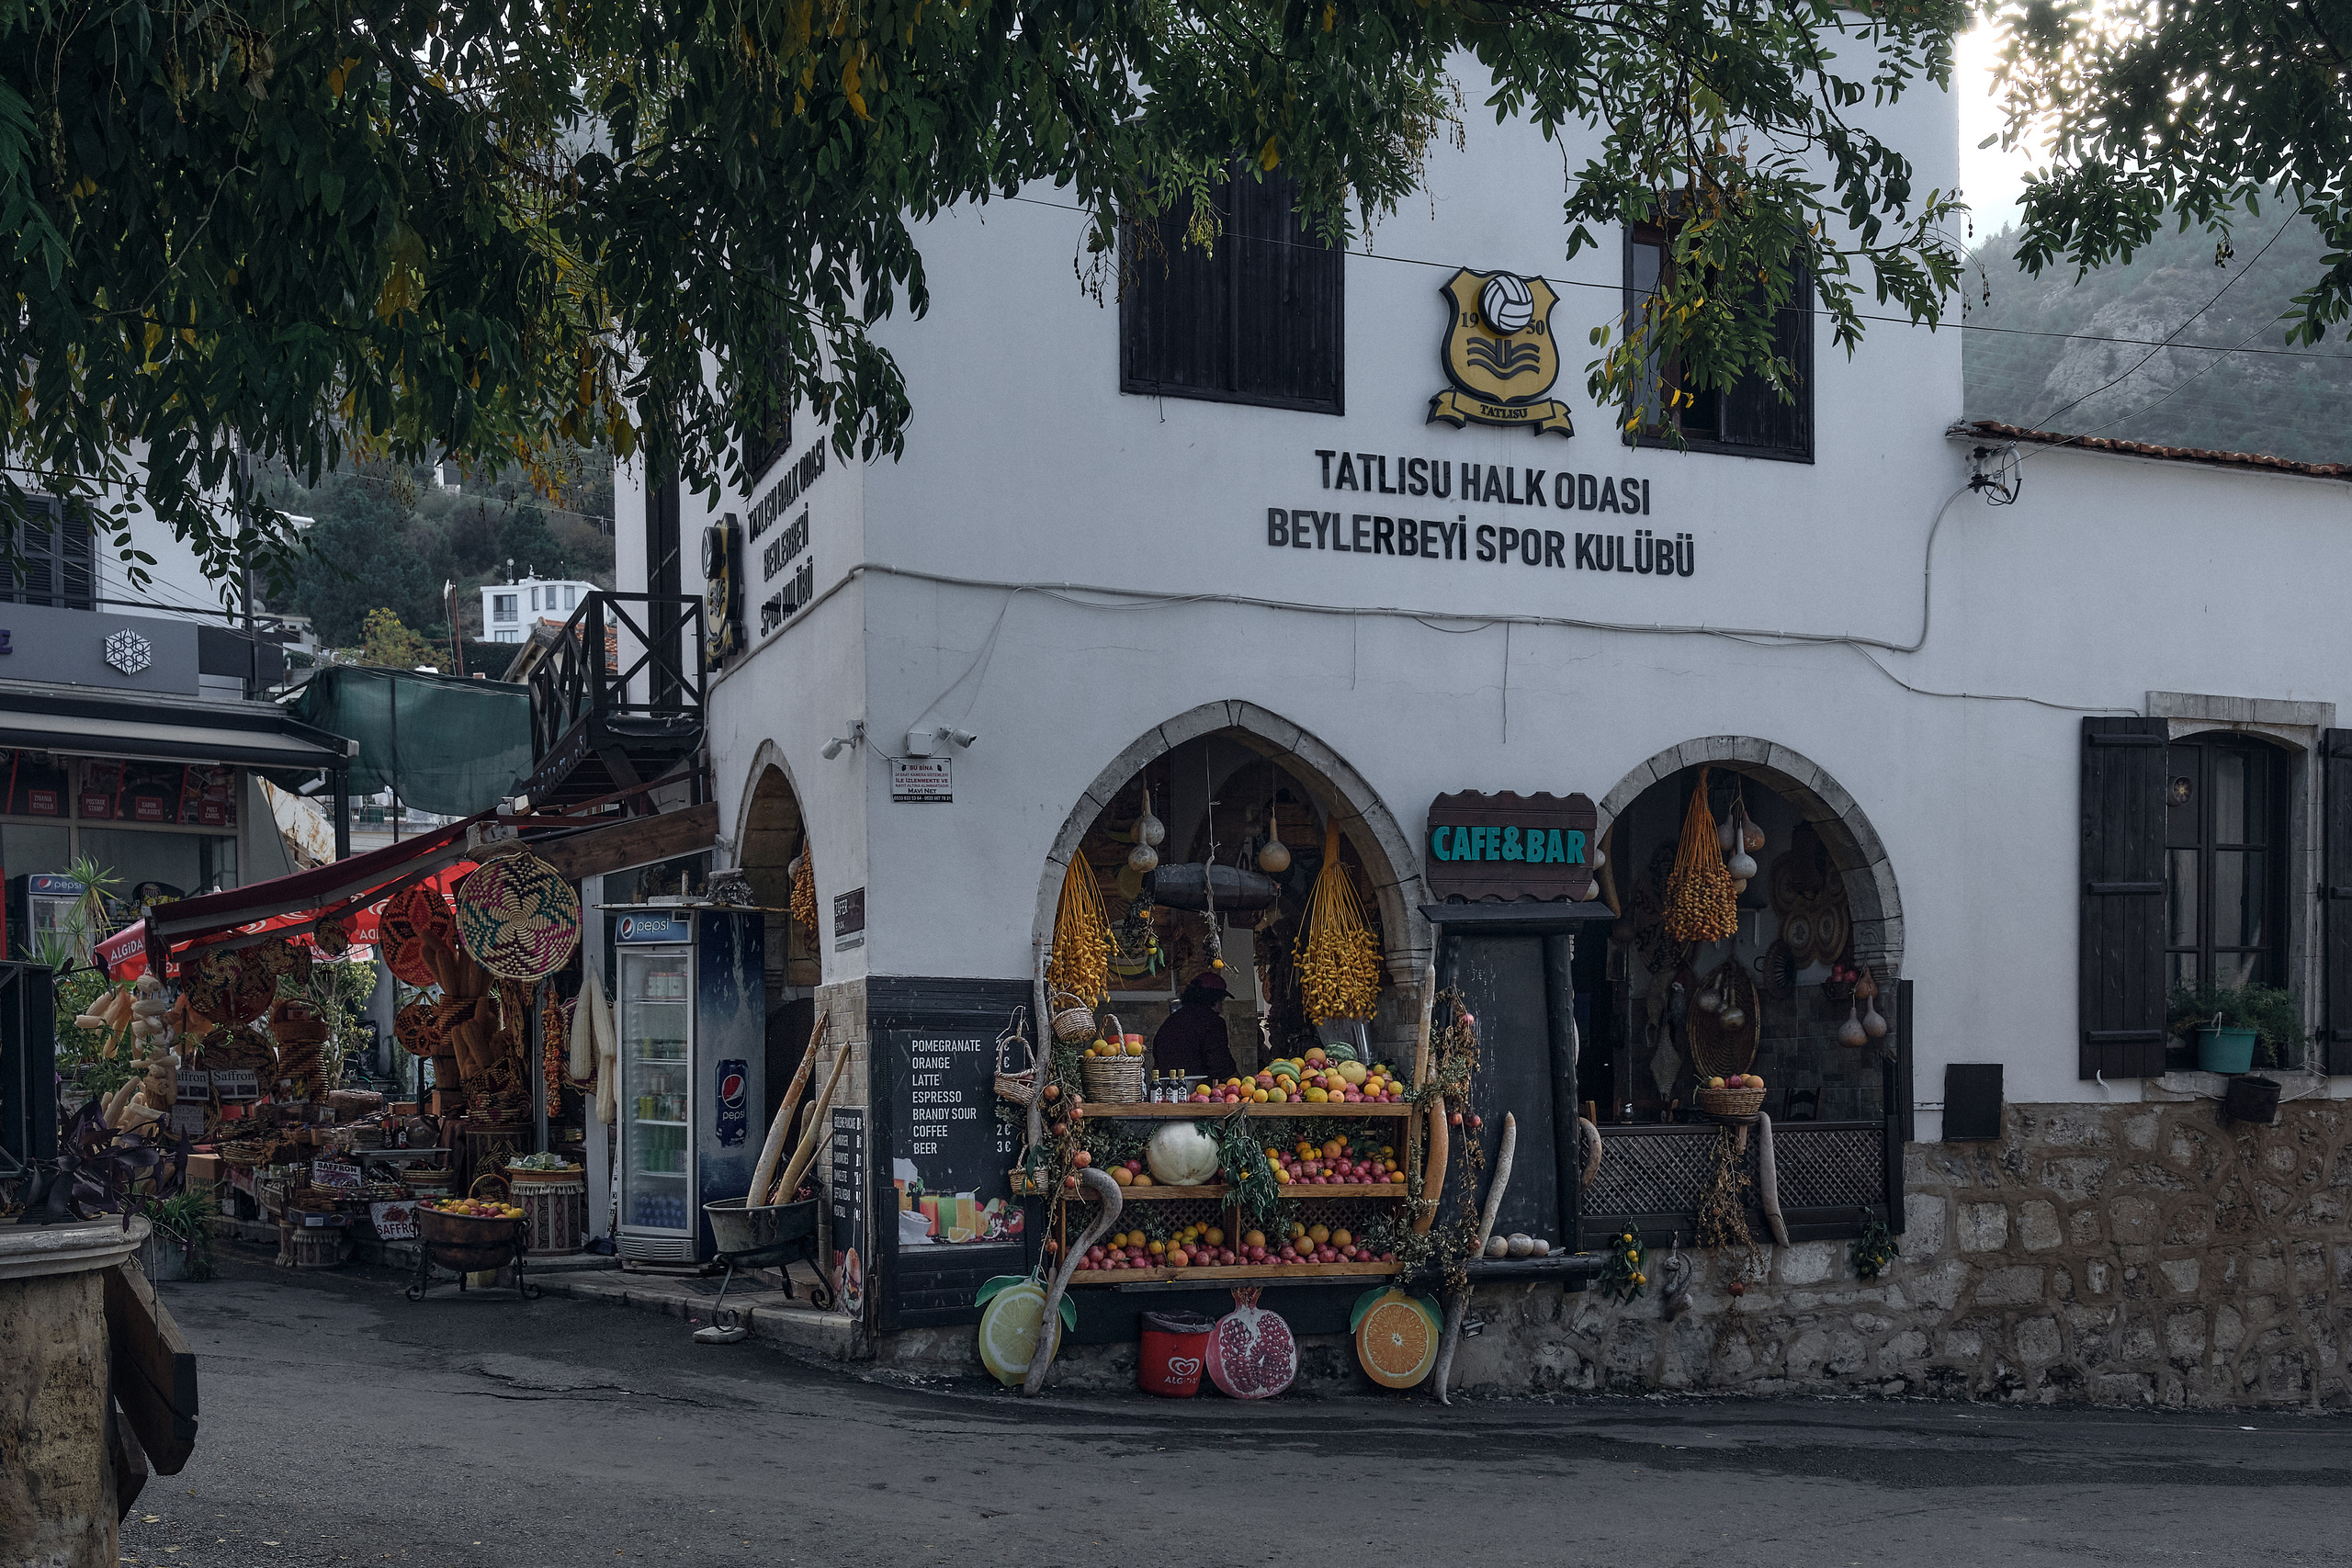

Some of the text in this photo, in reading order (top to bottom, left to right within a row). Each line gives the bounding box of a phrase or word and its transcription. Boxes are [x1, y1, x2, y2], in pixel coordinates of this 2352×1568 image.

[1461, 312, 1545, 335] 19 50
[1480, 404, 1528, 419] TATLISU
[1315, 449, 1650, 515] TATLISU HALK ODASI
[748, 434, 826, 544] TATLISU HALK ODASI
[763, 502, 809, 582] BEYLERBEYİ
[1268, 507, 1695, 577] BEYLERBEYİ SPOR KULÜBÜ
[1431, 826, 1586, 863] CAFE&BAR
[636, 918, 670, 934] pepsi
[911, 1040, 981, 1053] POMEGRANATE
[912, 1056, 950, 1069] ORANGE
[176, 1070, 206, 1082] affron
[213, 1071, 255, 1082] Saffron
[912, 1074, 939, 1086] LATTE
[912, 1090, 962, 1102] ESPRESSO
[722, 1110, 744, 1121] pepsi
[913, 1108, 978, 1121] BRANDY SOUR
[913, 1124, 948, 1137] COFFEE
[996, 1124, 1002, 1135] 2
[913, 1142, 937, 1154] BEER
[997, 1141, 1002, 1152] 3
[318, 1162, 357, 1173] SAFFRON
[377, 1223, 416, 1235] SAFFRO
